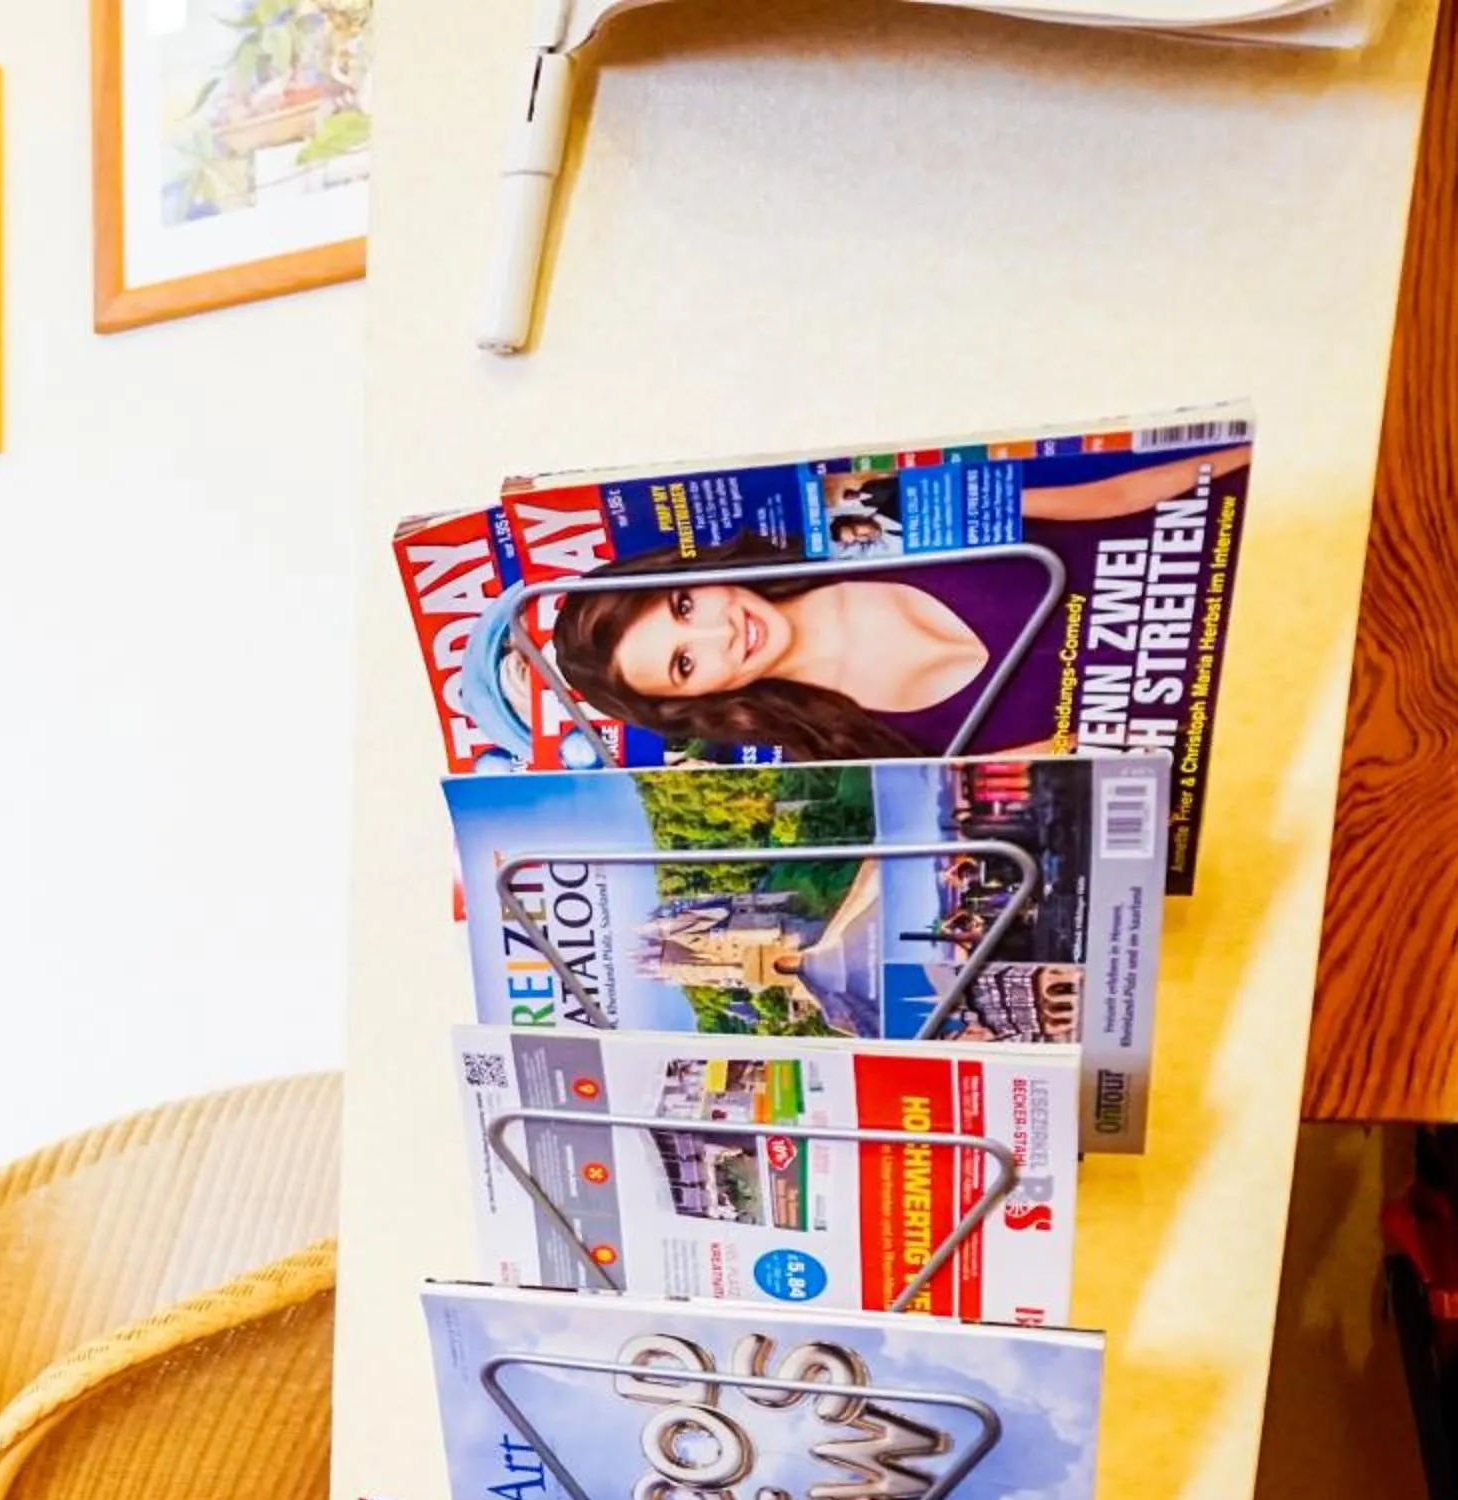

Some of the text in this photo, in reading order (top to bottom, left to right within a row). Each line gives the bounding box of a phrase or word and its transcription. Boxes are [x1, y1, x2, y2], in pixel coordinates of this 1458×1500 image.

[515, 503, 612, 736] TAY
[1051, 594, 1085, 756] Scheidungs-Comedy
[1087, 538, 1149, 651] ZWEI
[1133, 463, 1213, 703] STREITEN...
[1170, 496, 1236, 873] Annette Frier & Christoph Maria Herbst im Interview
[901, 1096, 933, 1265] HOHWERTIG
